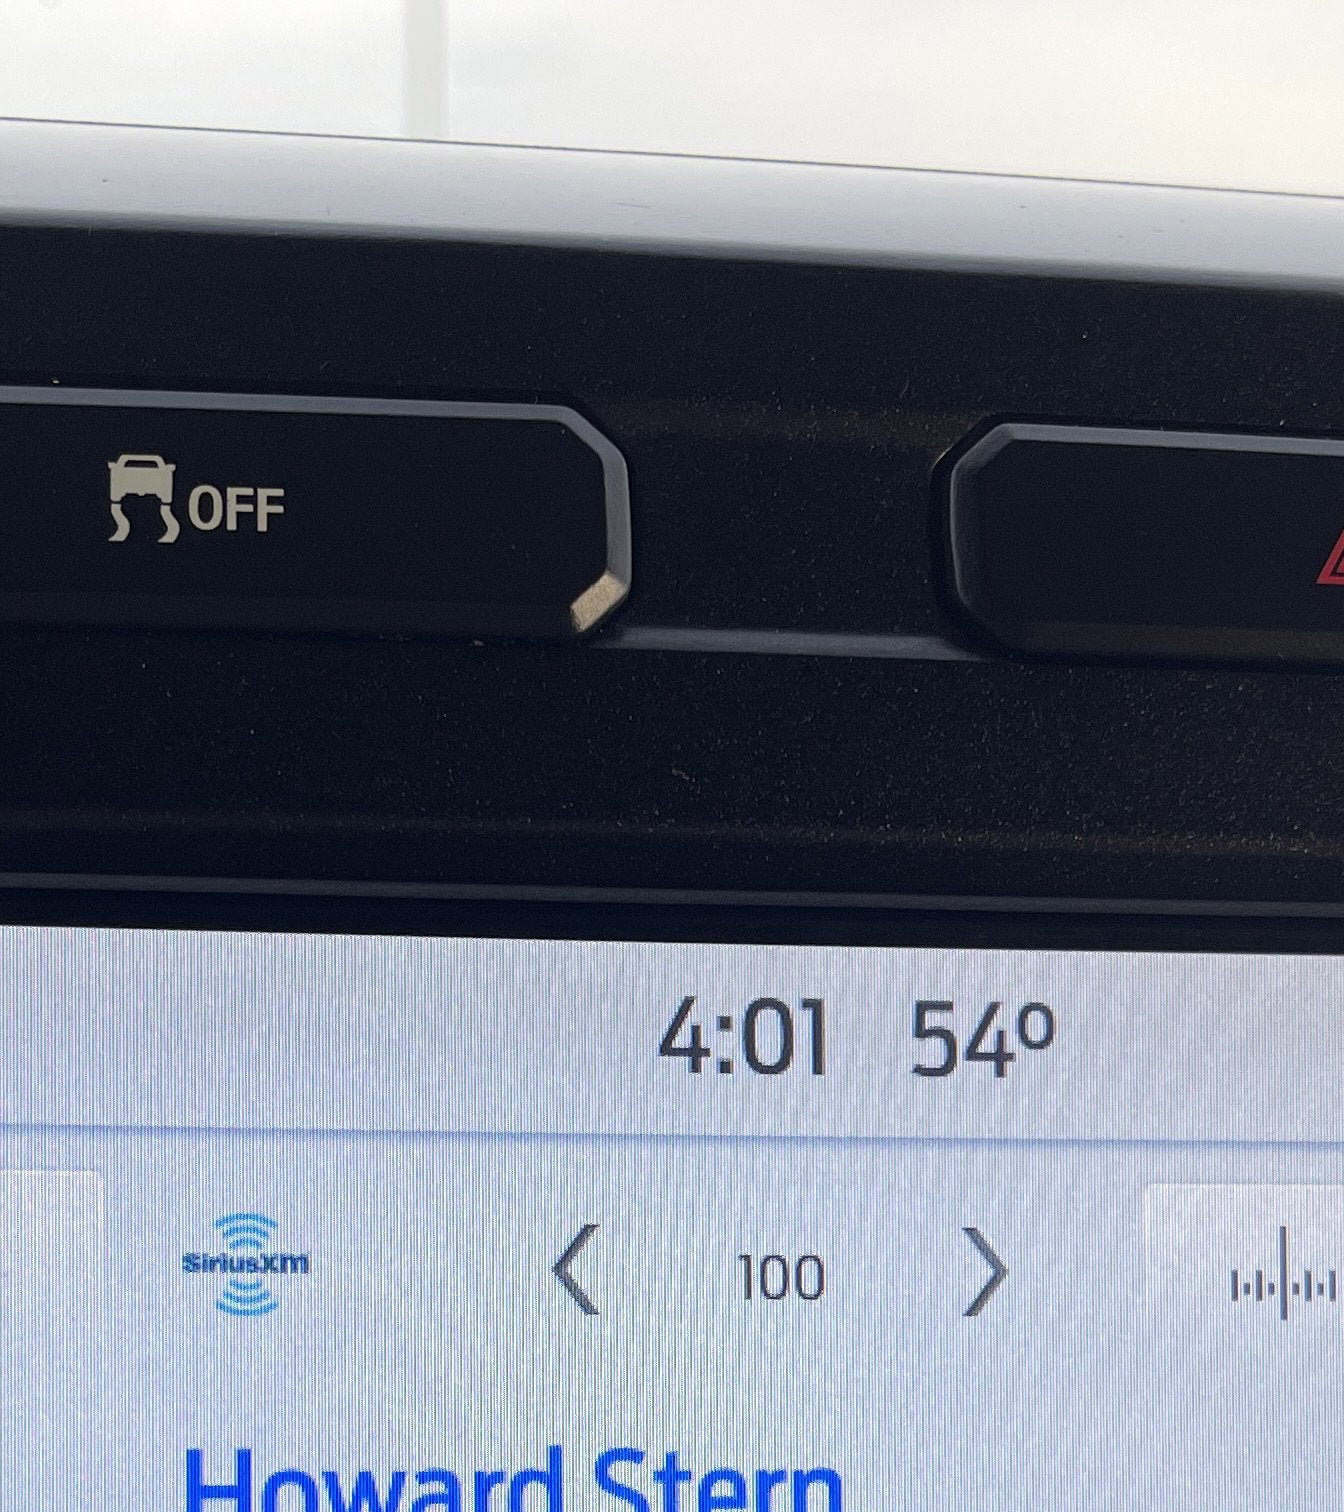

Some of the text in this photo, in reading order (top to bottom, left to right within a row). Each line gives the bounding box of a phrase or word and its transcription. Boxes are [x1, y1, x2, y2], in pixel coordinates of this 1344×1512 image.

[188, 484, 285, 533] OFF
[658, 996, 827, 1074] 4:01
[739, 1254, 826, 1301] 100
